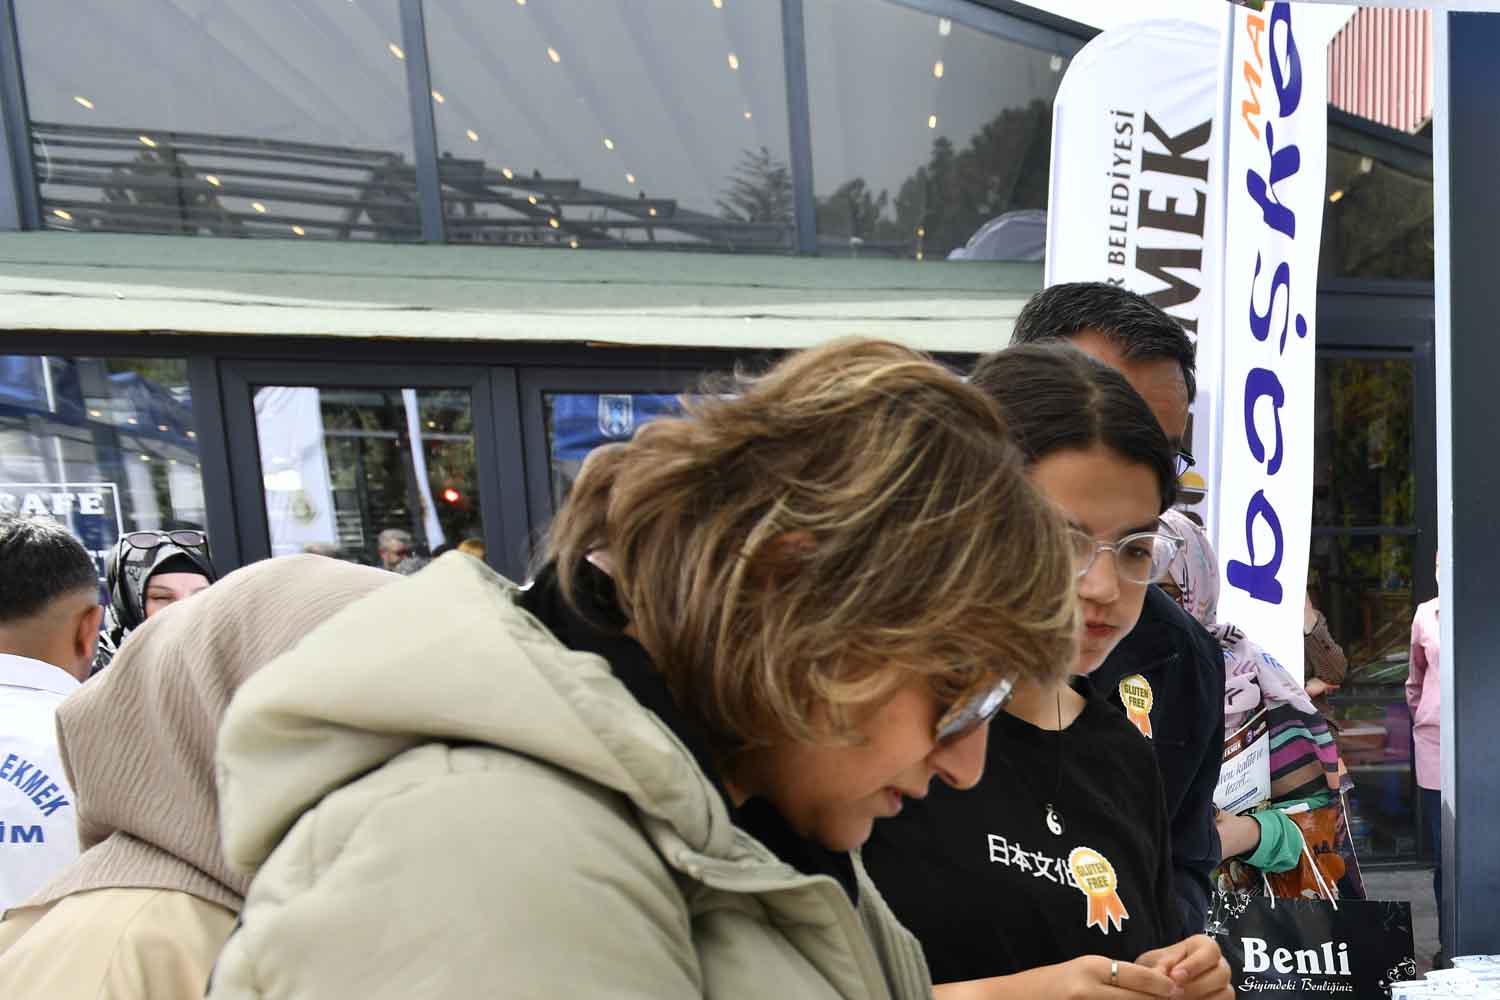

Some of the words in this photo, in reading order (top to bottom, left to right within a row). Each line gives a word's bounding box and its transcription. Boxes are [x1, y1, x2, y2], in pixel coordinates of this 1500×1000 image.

[1241, 12, 1265, 141] MA
[1106, 109, 1135, 266] BELEDİYESİ
[1135, 110, 1213, 360] MEK
[1123, 682, 1150, 698] GLUTEN
[1128, 695, 1146, 710] FREE
[0, 753, 70, 818] EKMEK
[1075, 862, 1108, 879] GLUTEN
[1086, 876, 1110, 891] FREE
[1240, 936, 1352, 976] Benli
[1238, 975, 1297, 993] Giyimdeki
